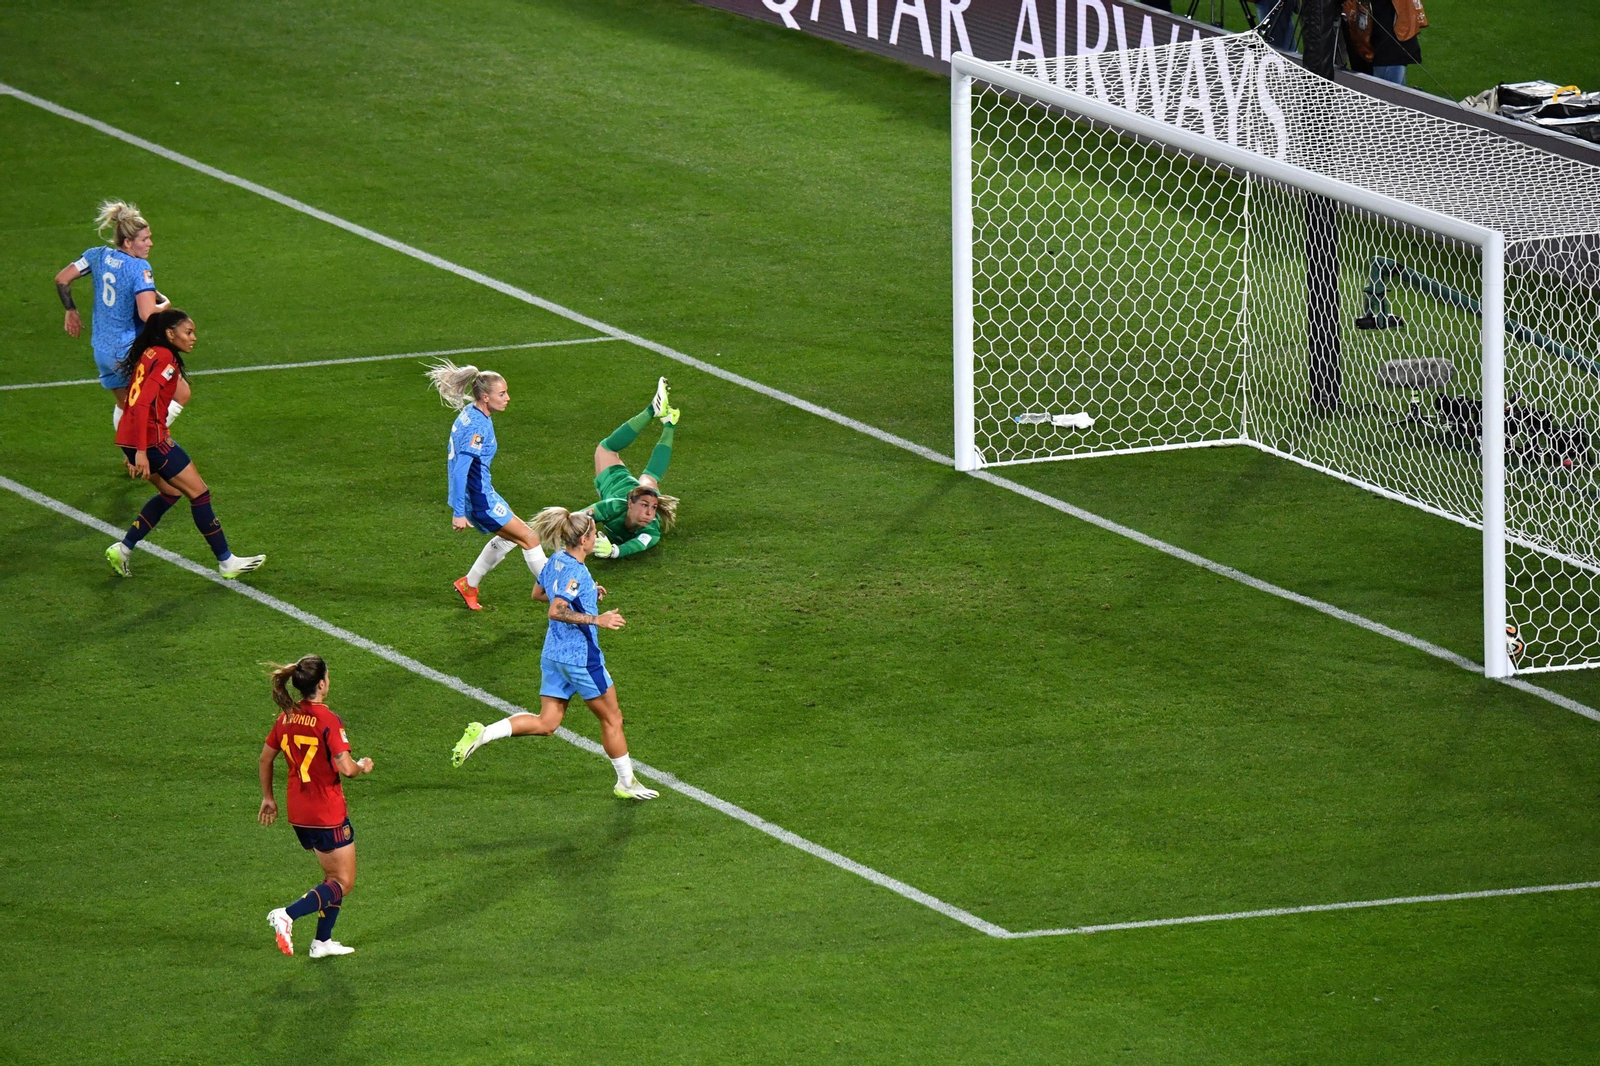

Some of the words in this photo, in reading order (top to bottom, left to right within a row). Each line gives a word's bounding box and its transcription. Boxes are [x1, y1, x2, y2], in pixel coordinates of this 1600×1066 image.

[1011, 0, 1288, 166] AIRWAYS
[103, 272, 116, 307] 6
[124, 363, 145, 407] 8
[282, 713, 317, 727] RONDO
[280, 733, 319, 783] 17
